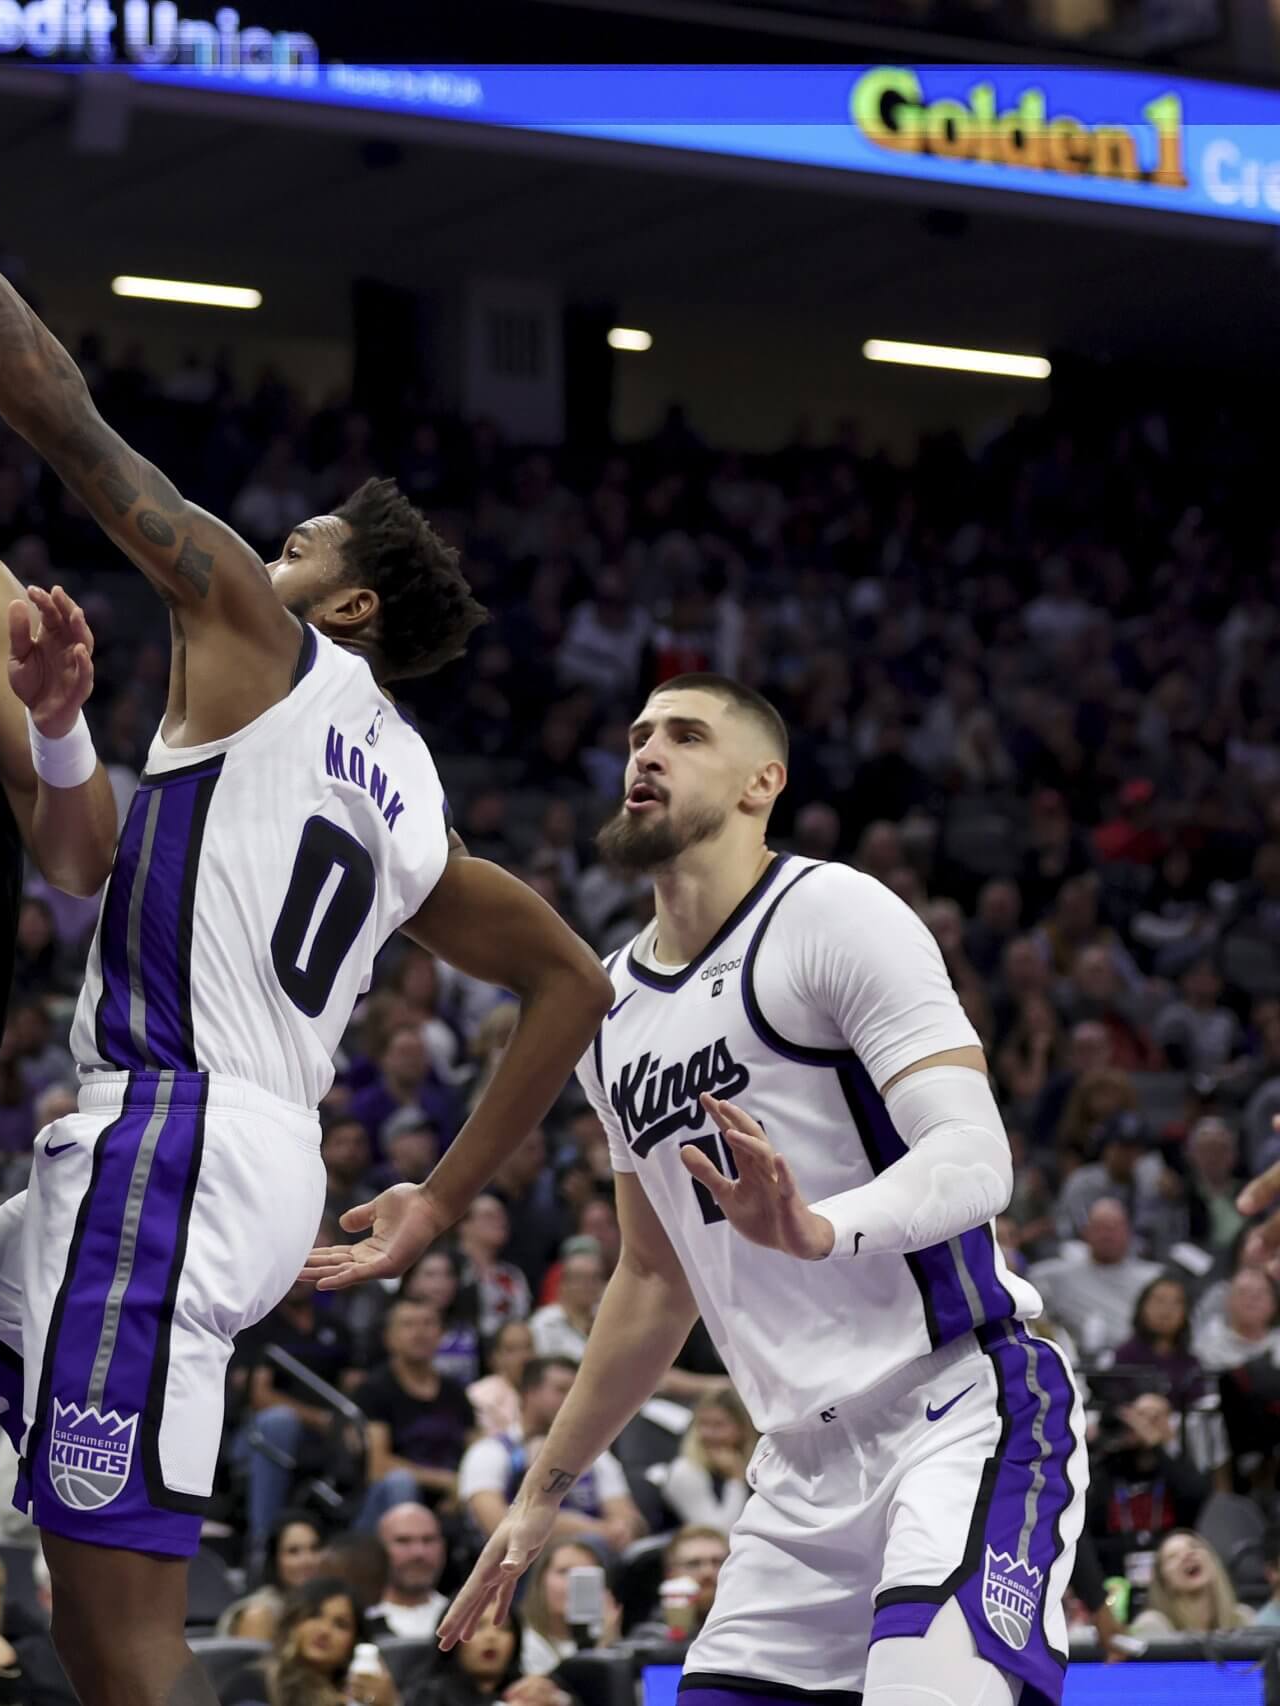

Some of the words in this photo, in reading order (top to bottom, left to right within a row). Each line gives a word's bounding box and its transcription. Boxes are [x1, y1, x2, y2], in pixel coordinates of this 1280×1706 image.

[123, 0, 319, 87] Union
[325, 724, 405, 834] MONK
[270, 814, 377, 1018] 0
[611, 1036, 750, 1159] Kings
[51, 1442, 128, 1476] KINGS
[55, 1430, 127, 1452] SACRAMENTO
